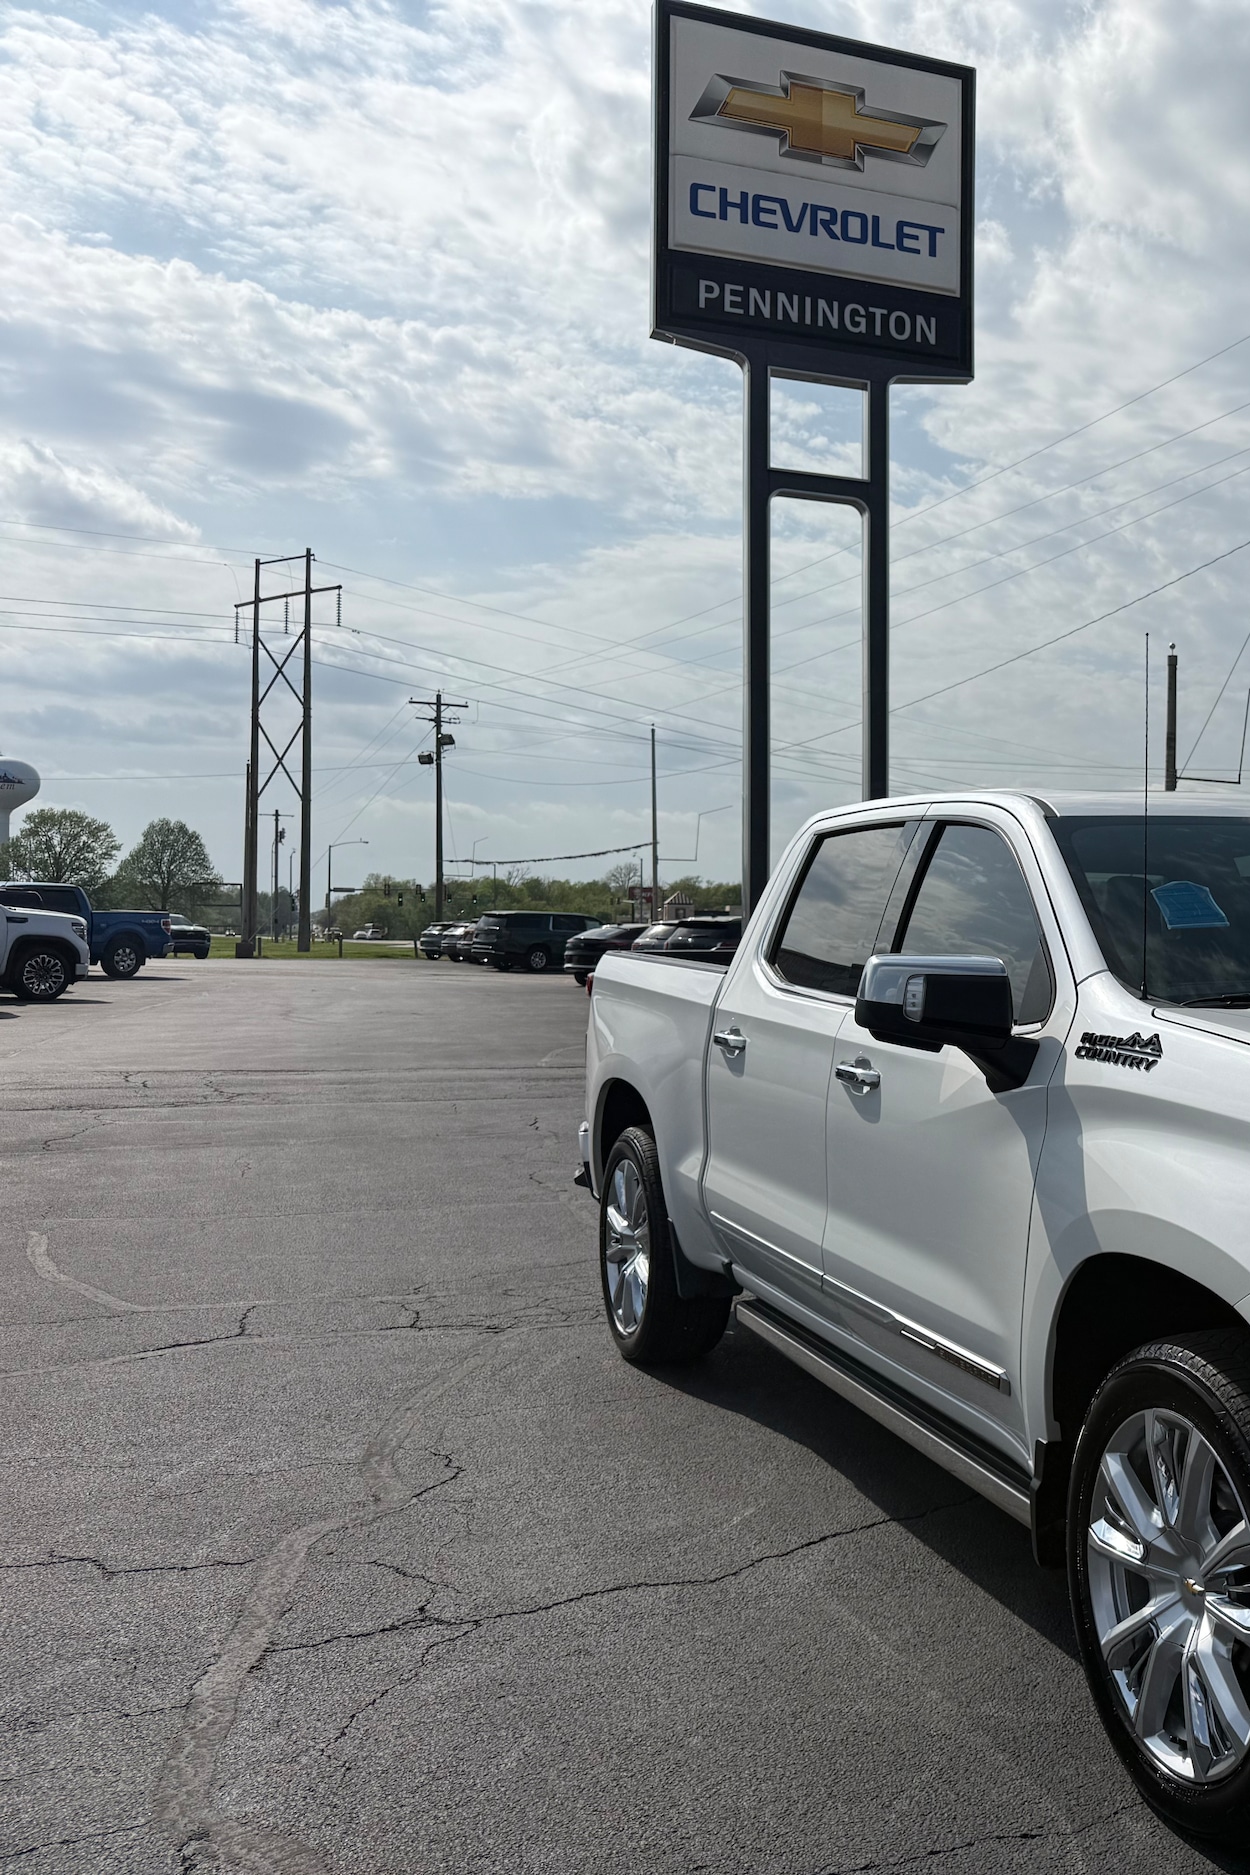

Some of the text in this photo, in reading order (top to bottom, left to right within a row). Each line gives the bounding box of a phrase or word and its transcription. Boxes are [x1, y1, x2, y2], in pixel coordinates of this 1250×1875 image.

[689, 182, 945, 257] CHEVROLET
[698, 279, 937, 345] PENNINGTON
[1074, 1045, 1159, 1073] COUNTRY
[1080, 1032, 1123, 1048] HIGH
